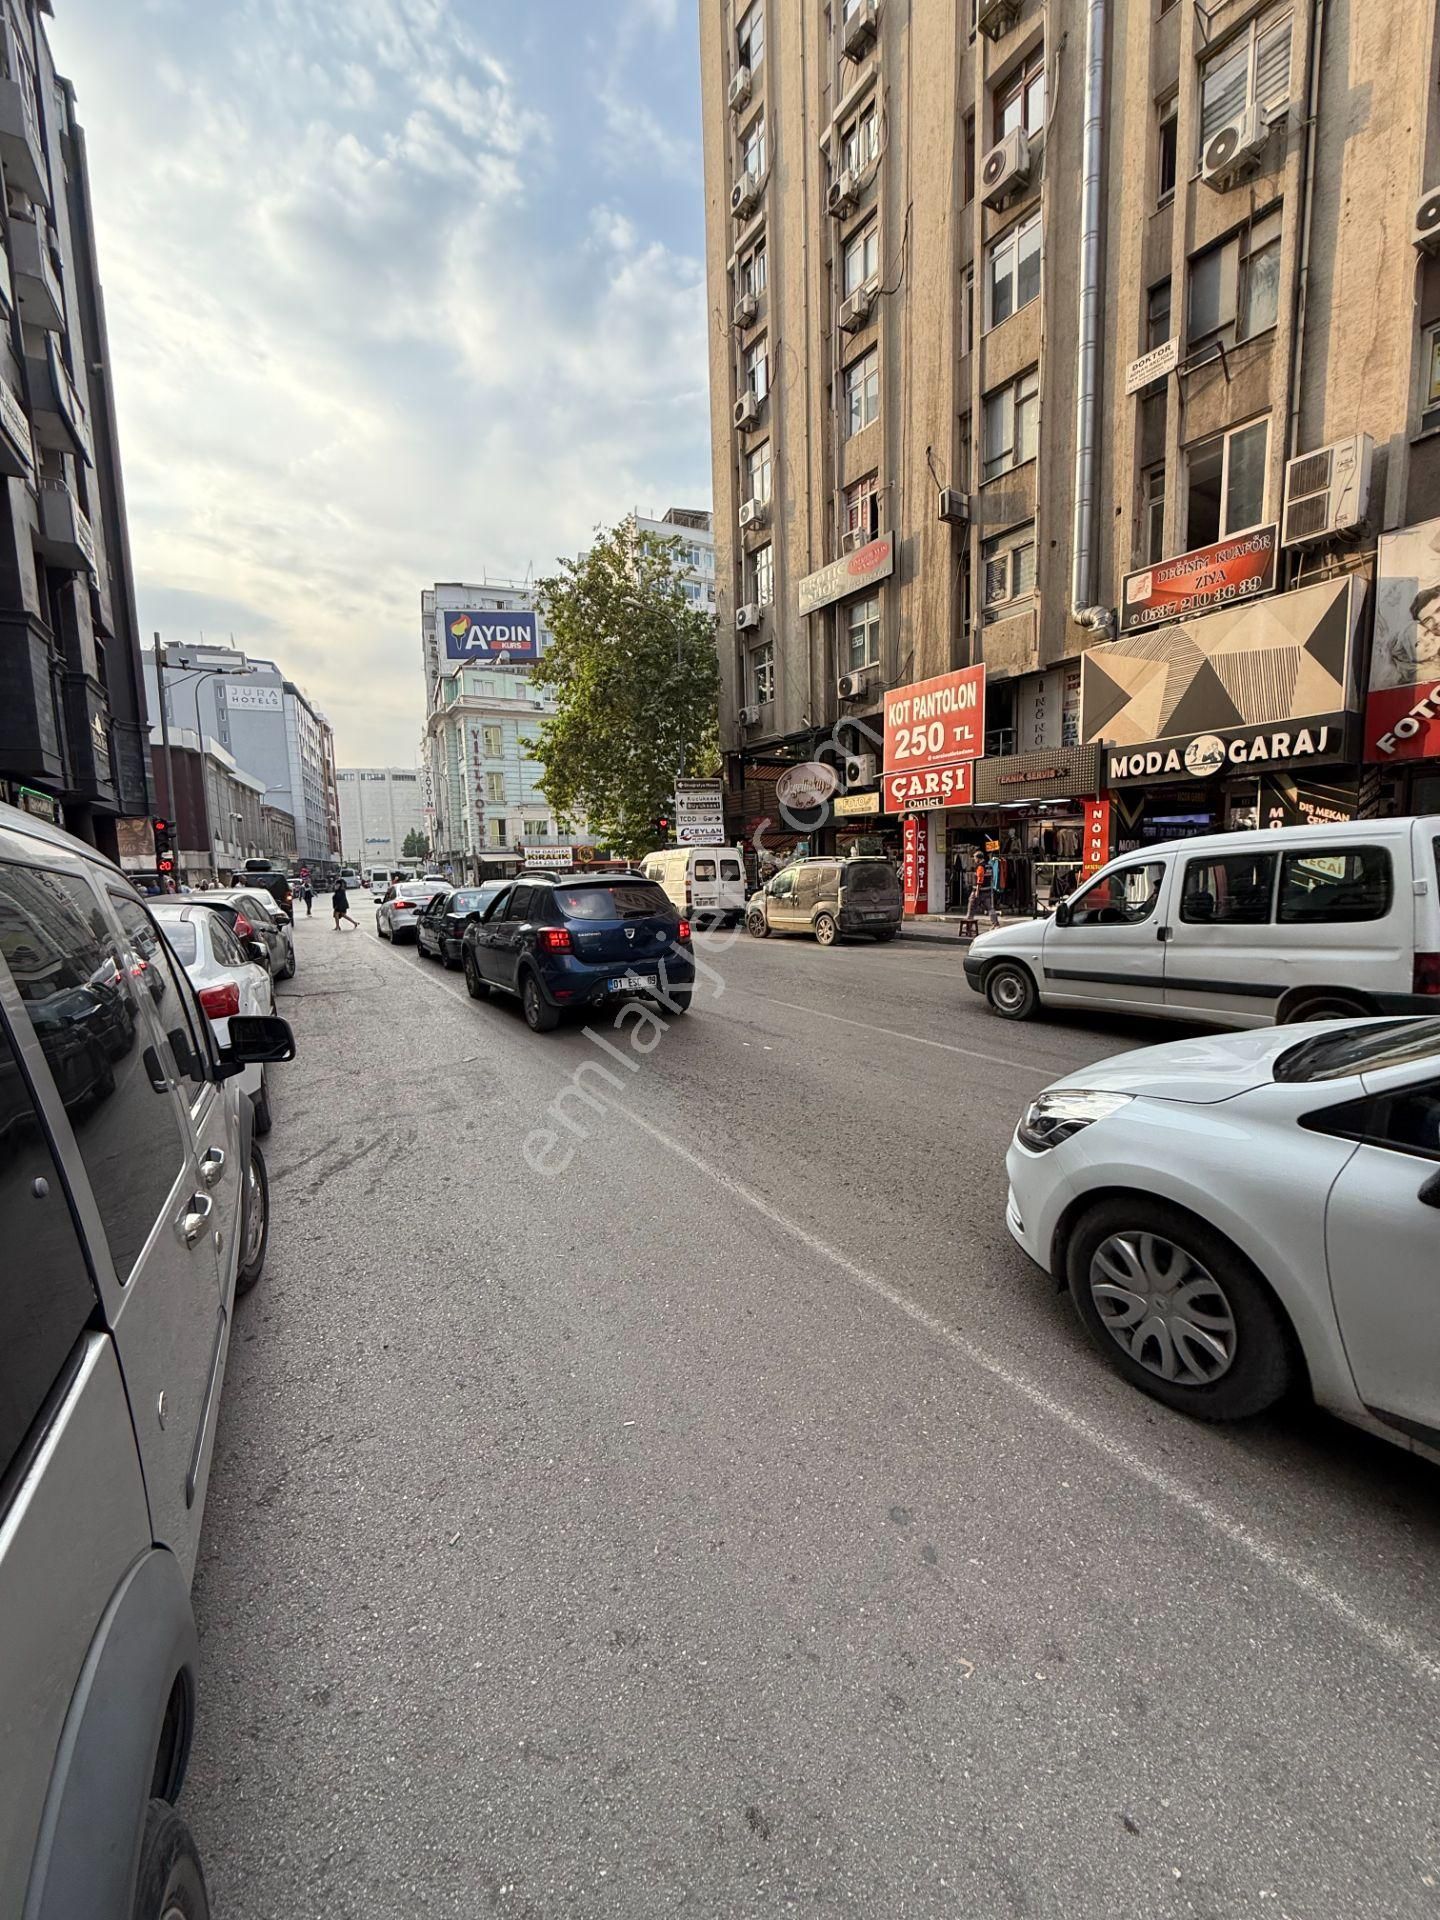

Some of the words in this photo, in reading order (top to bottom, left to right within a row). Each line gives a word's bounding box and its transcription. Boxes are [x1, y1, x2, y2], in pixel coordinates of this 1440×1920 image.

[1132, 344, 1171, 371] DOKTOR
[1181, 591, 1211, 612] 210
[465, 625, 531, 650] AYDIN
[232, 688, 277, 698] JURA
[888, 700, 911, 727] KOT
[913, 681, 977, 720] PANTOLON
[894, 721, 945, 759] 250
[953, 725, 974, 741] TL
[1110, 748, 1181, 779] MODA
[1229, 726, 1328, 764] GARAJ
[891, 769, 965, 803] ÇARŞI
[997, 772, 1025, 784] TEKNİK
[1026, 769, 1055, 780] SERVİS
[843, 797, 866, 808] FOTO
[908, 796, 940, 809] Outlet
[1299, 801, 1314, 815] DIŞ
[1316, 806, 1350, 822] MEKAN
[159, 861, 171, 870] 20
[905, 829, 914, 887] ÇARŞI
[918, 830, 926, 888] ÇARŞI
[613, 980, 622, 989] 01
